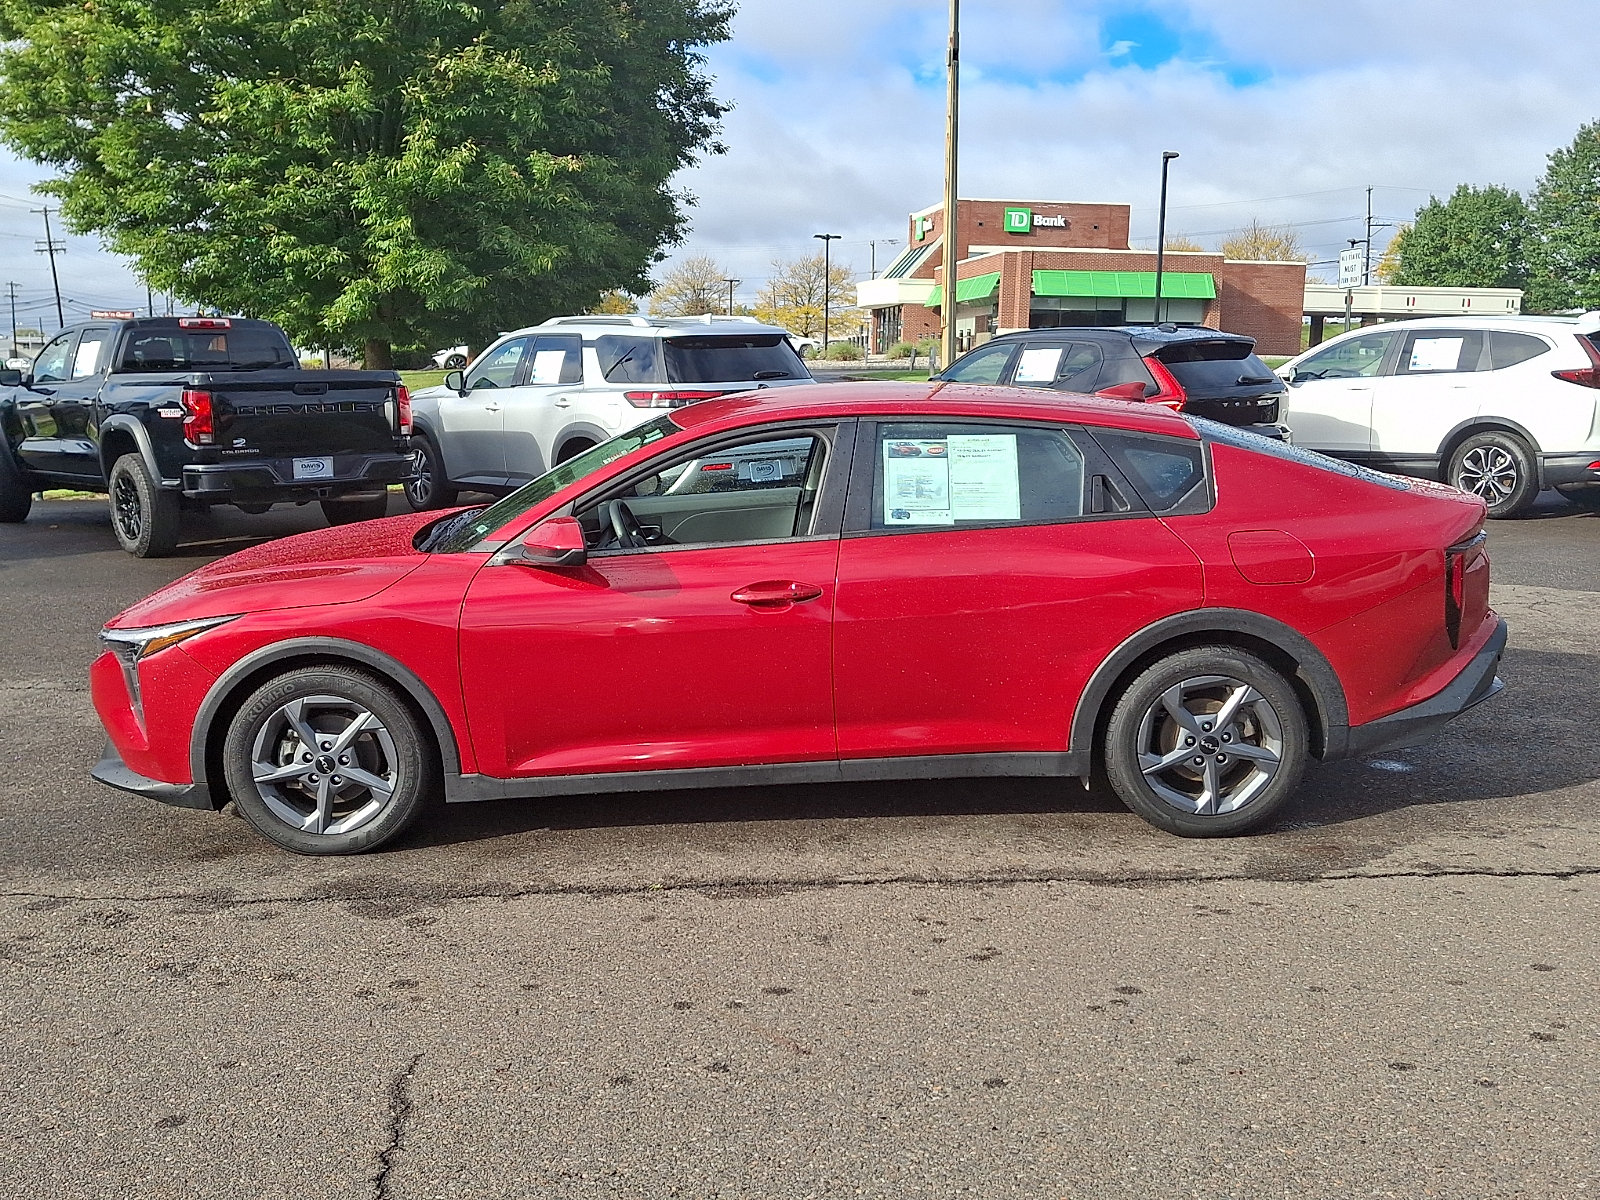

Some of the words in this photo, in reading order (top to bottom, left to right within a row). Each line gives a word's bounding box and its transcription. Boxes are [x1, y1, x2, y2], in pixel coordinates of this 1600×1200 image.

[1008, 211, 1028, 227] TD
[1033, 214, 1066, 227] Bank
[236, 403, 377, 416] CHEVROLET
[246, 683, 295, 722] KUMHO
